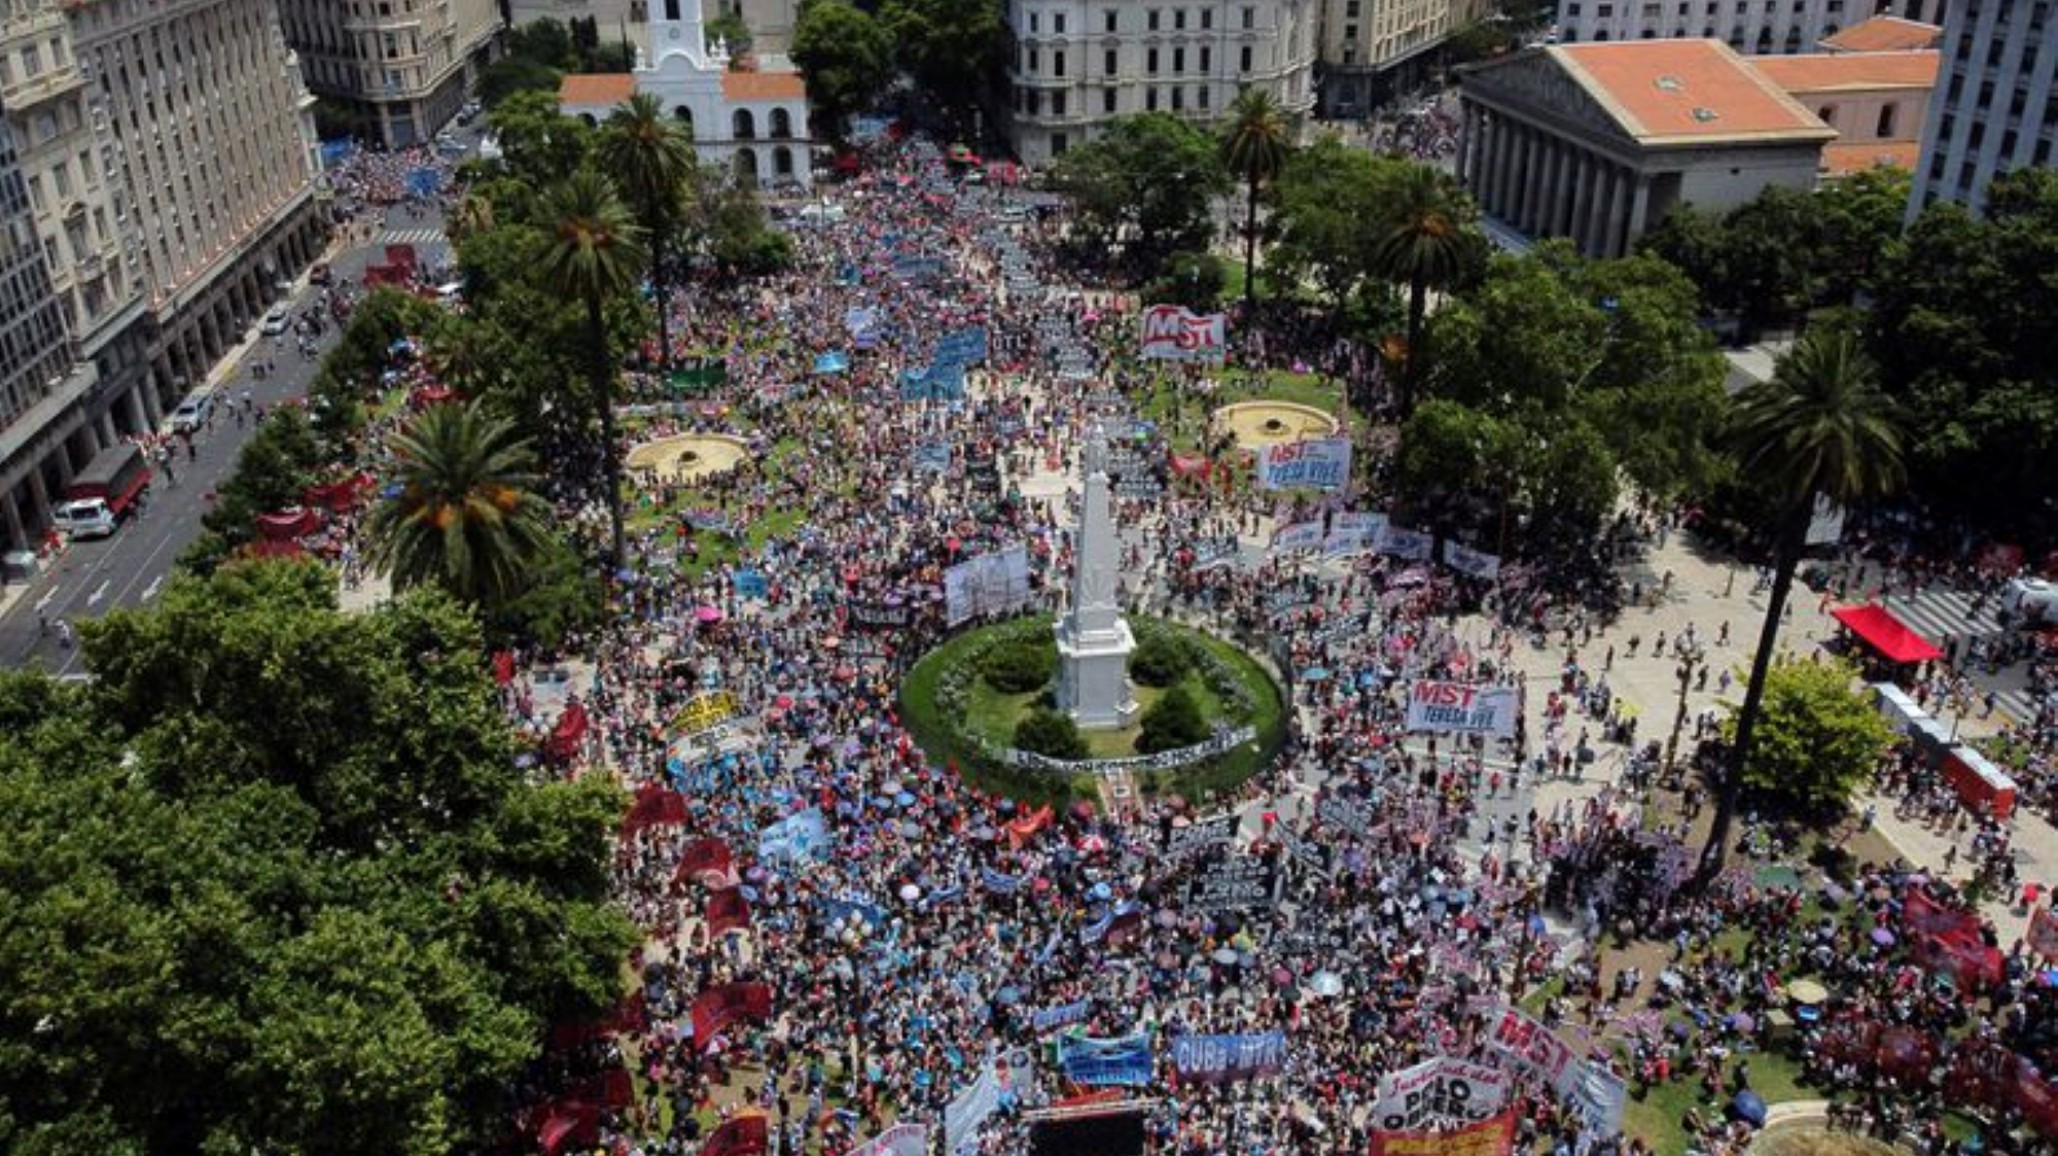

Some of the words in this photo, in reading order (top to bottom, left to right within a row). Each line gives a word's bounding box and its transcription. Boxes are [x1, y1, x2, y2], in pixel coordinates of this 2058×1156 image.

[1144, 305, 1214, 350] MST
[1269, 440, 1306, 463] MST
[1414, 681, 1478, 709] MST
[1495, 1008, 1574, 1081] MST
